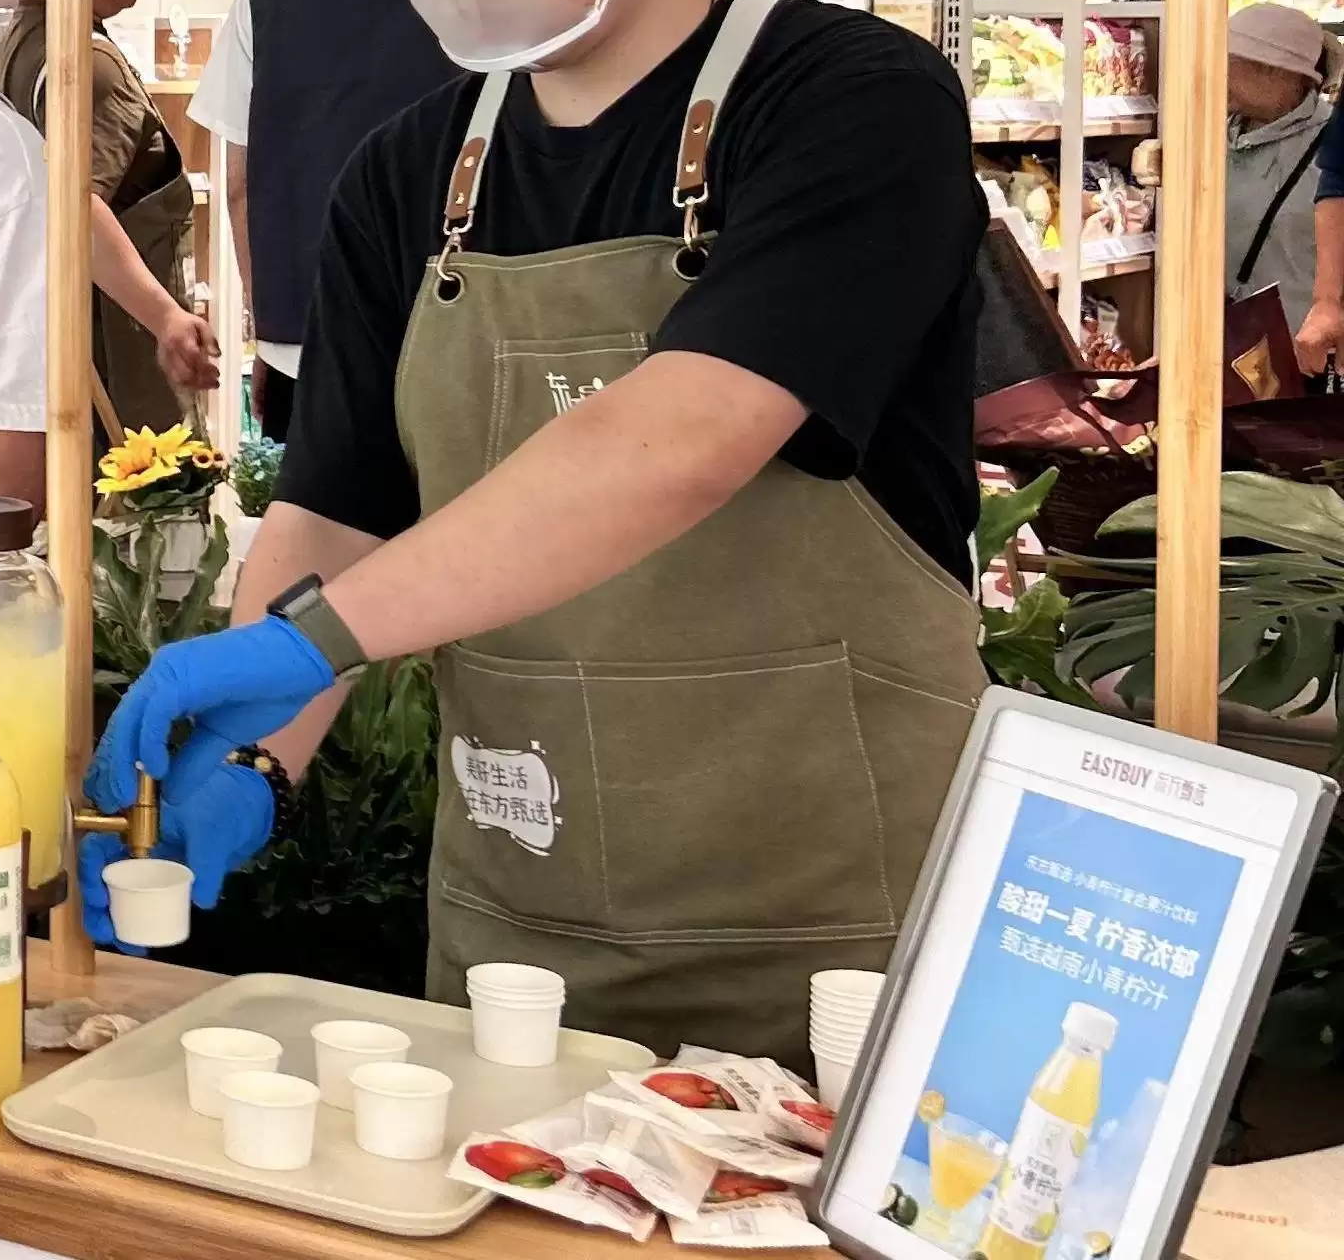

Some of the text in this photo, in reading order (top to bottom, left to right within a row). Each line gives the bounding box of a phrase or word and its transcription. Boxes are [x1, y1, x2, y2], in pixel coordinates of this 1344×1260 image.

[1080, 750, 1153, 790] EASTBUY
[996, 882, 1201, 980] 酸甜一夏 柠香浓郁
